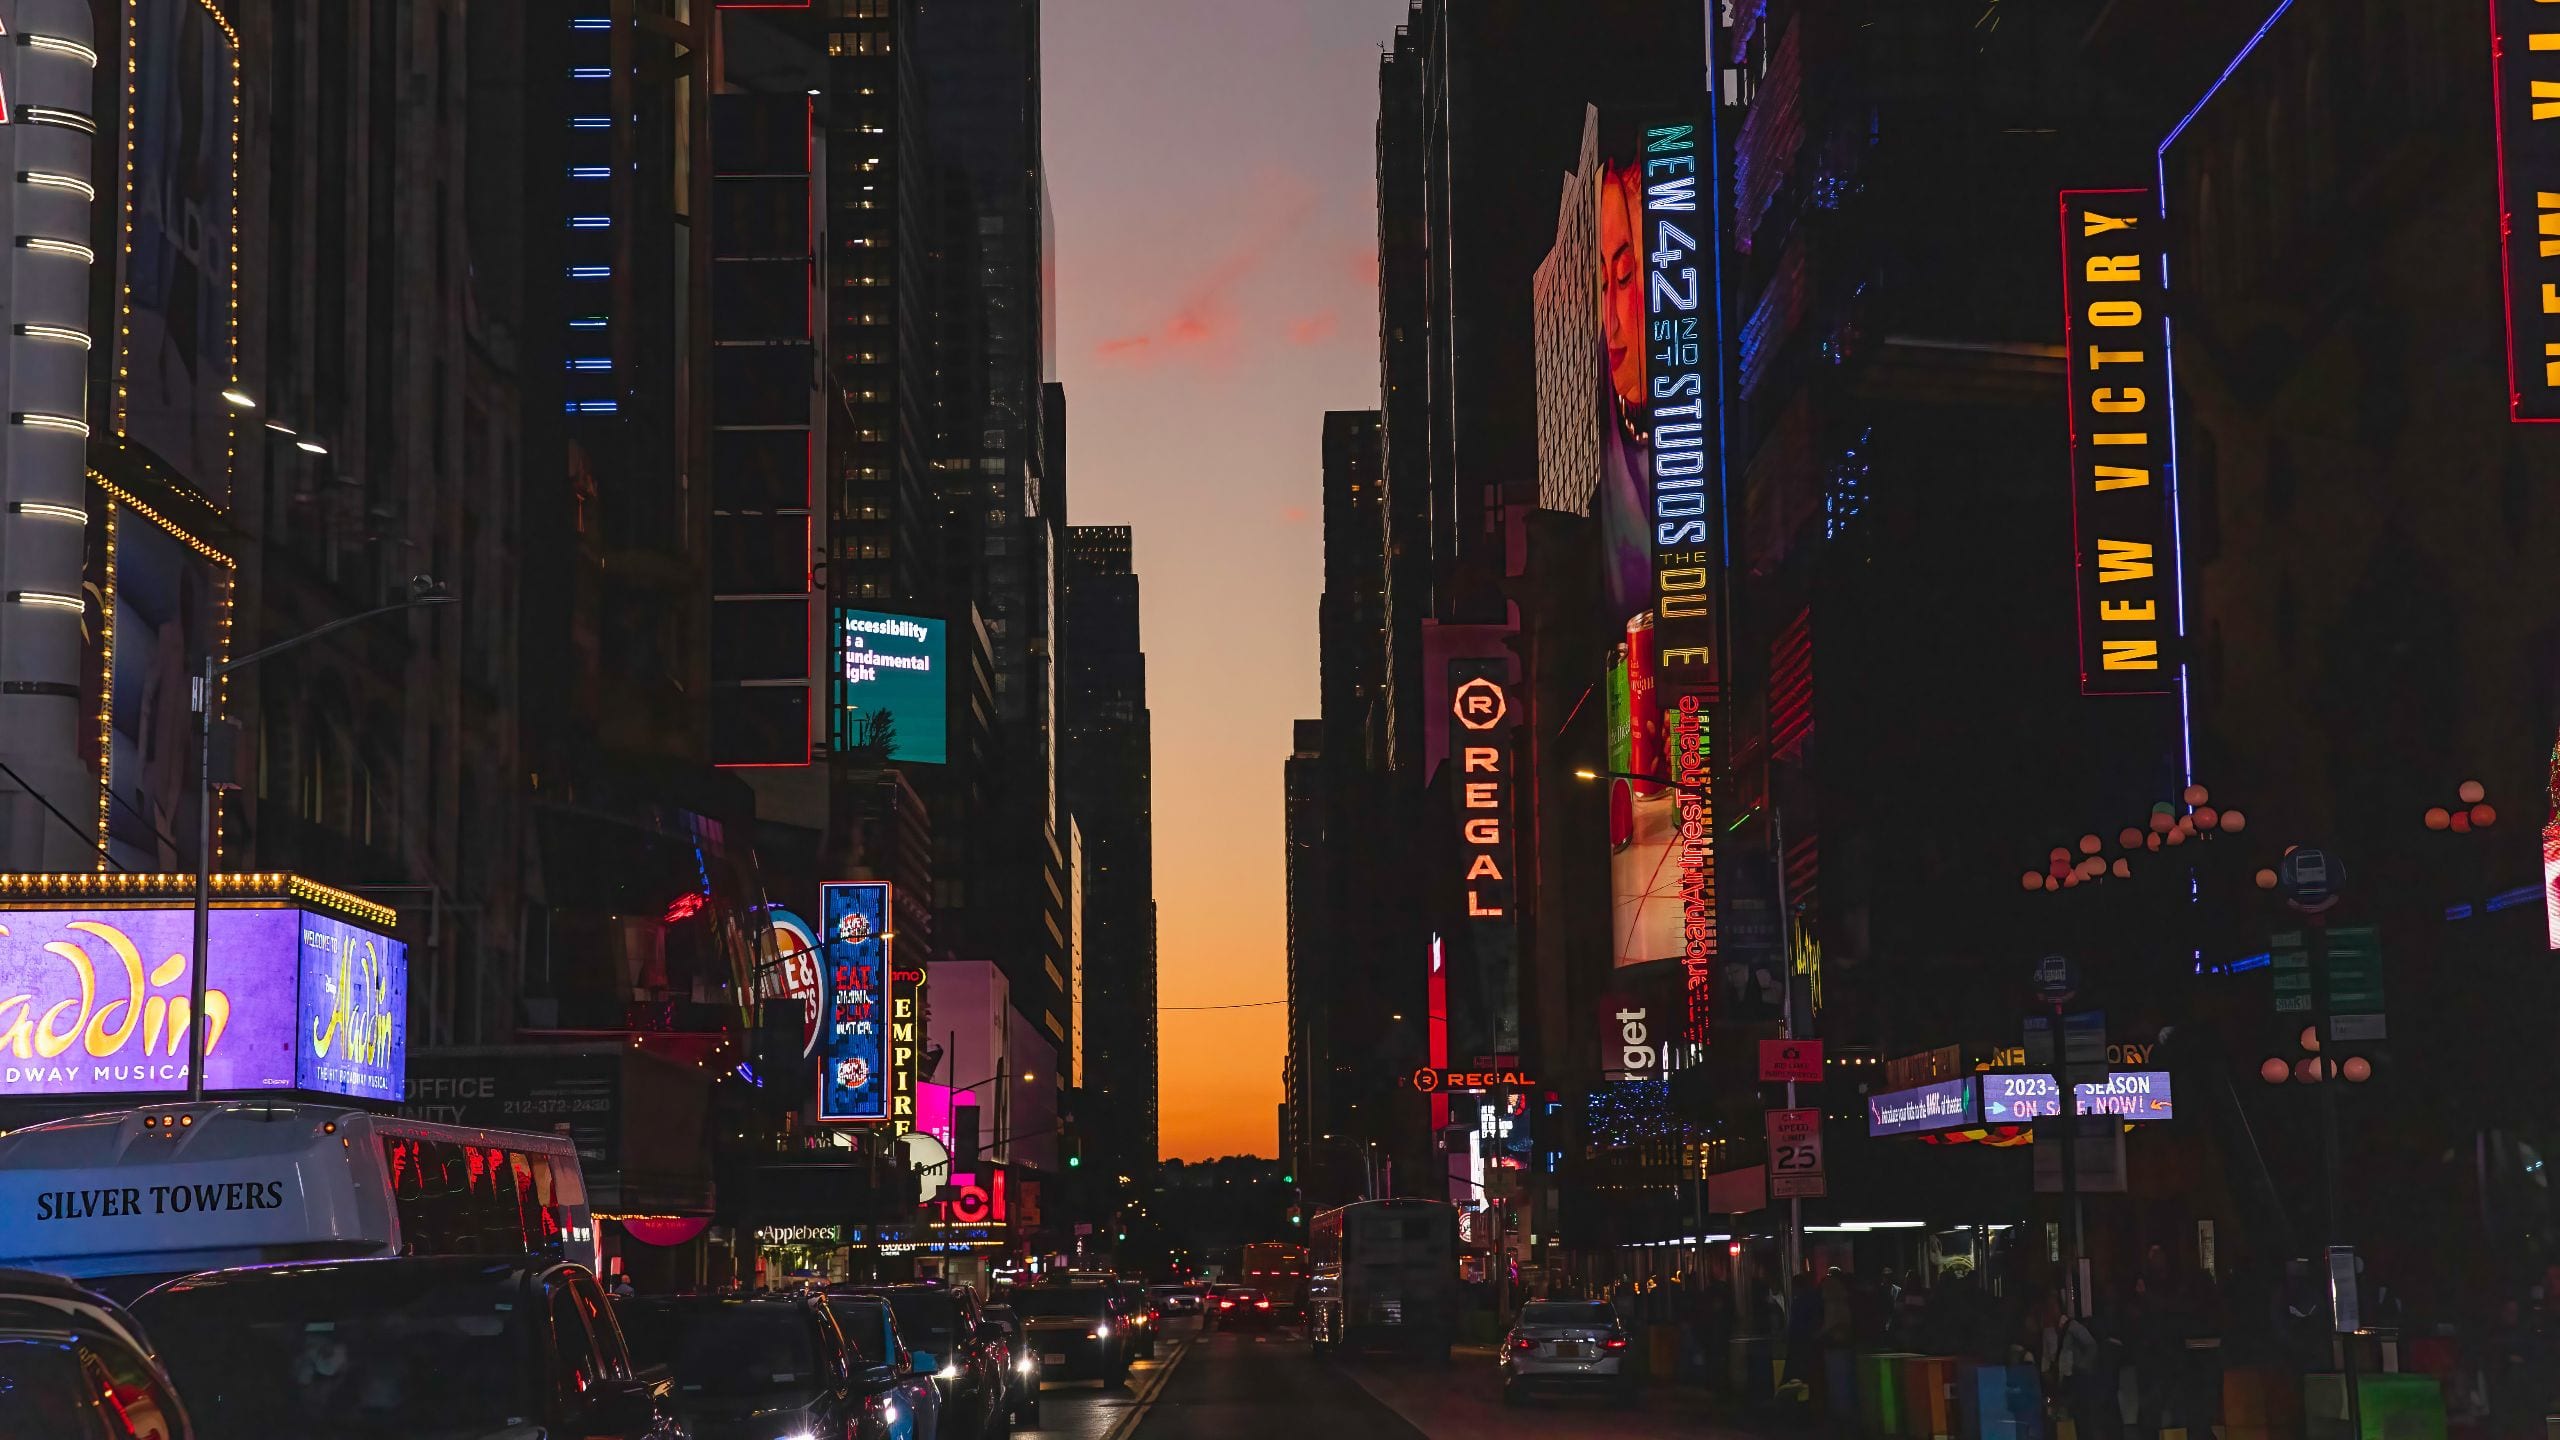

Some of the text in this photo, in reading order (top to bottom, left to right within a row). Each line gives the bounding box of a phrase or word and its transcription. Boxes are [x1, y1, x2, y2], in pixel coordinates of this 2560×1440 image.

[1648, 124, 1696, 211] NEW
[2083, 210, 2159, 671] NEW VICTORY
[1653, 373, 1707, 545] STUDIOS
[1660, 550, 1709, 667] THE DUE
[855, 636, 864, 648] a
[839, 650, 930, 671] undamental
[1464, 747, 1503, 916] REGAL
[303, 929, 338, 954] WELCOME TO
[0, 921, 230, 1058] addin
[313, 934, 394, 1070] Aladdin
[0, 1066, 80, 1084] DWAY
[317, 1066, 389, 1091] THE HIT BROADWAY MUSICAL
[1447, 1073, 1536, 1087] REGAL
[2013, 1100, 2038, 1118] ON
[2096, 1097, 2145, 1116] NOW!
[1776, 1145, 1817, 1170] 25
[36, 1180, 283, 1220] SILVER TOWERS
